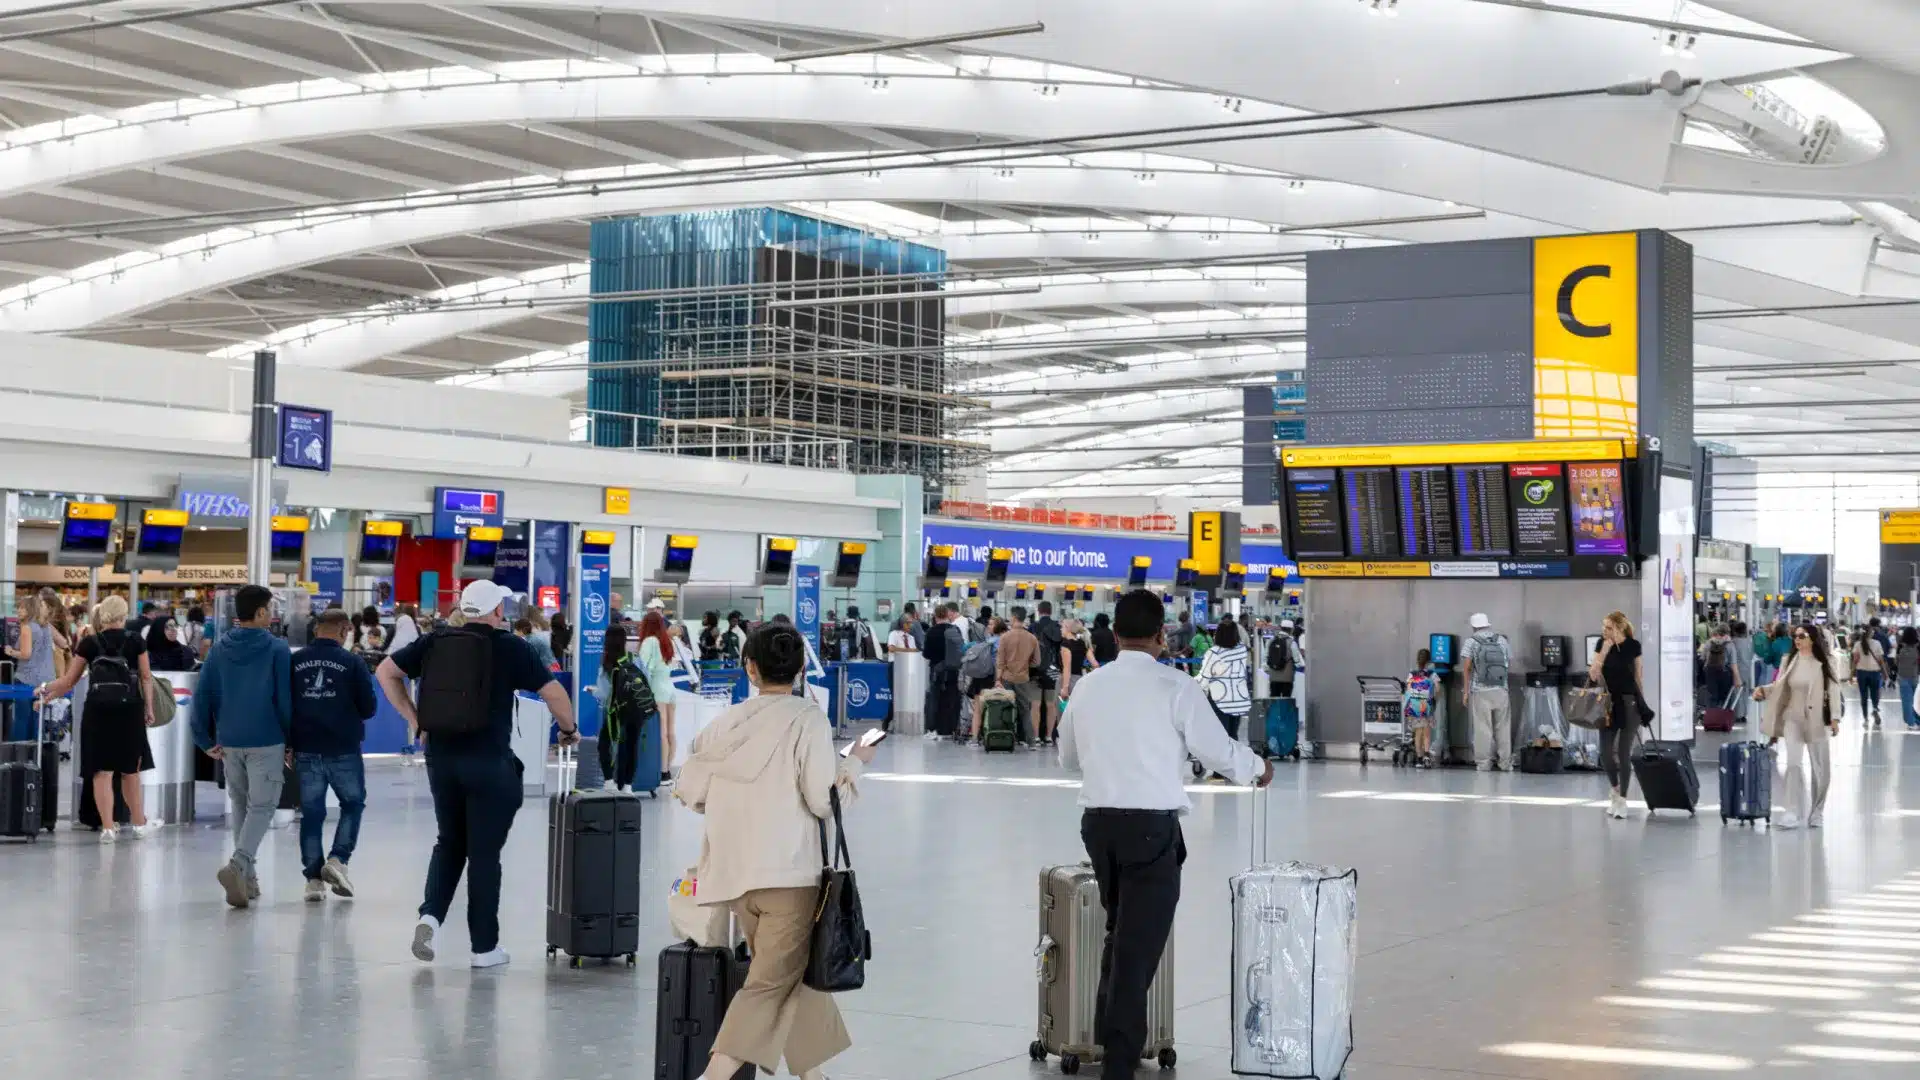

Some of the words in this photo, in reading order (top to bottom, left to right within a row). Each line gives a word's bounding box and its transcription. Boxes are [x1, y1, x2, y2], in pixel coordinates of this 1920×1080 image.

[1557, 265, 1612, 338] C
[1571, 469, 1577, 478] 2
[1580, 469, 1598, 478] FOR
[456, 515, 485, 527] Currency
[1201, 521, 1212, 540] E
[1029, 548, 1042, 565] to
[1045, 550, 1066, 566] our
[1069, 546, 1109, 568] home.
[177, 569, 236, 579] BESTSELLING
[322, 660, 347, 673] COAST
